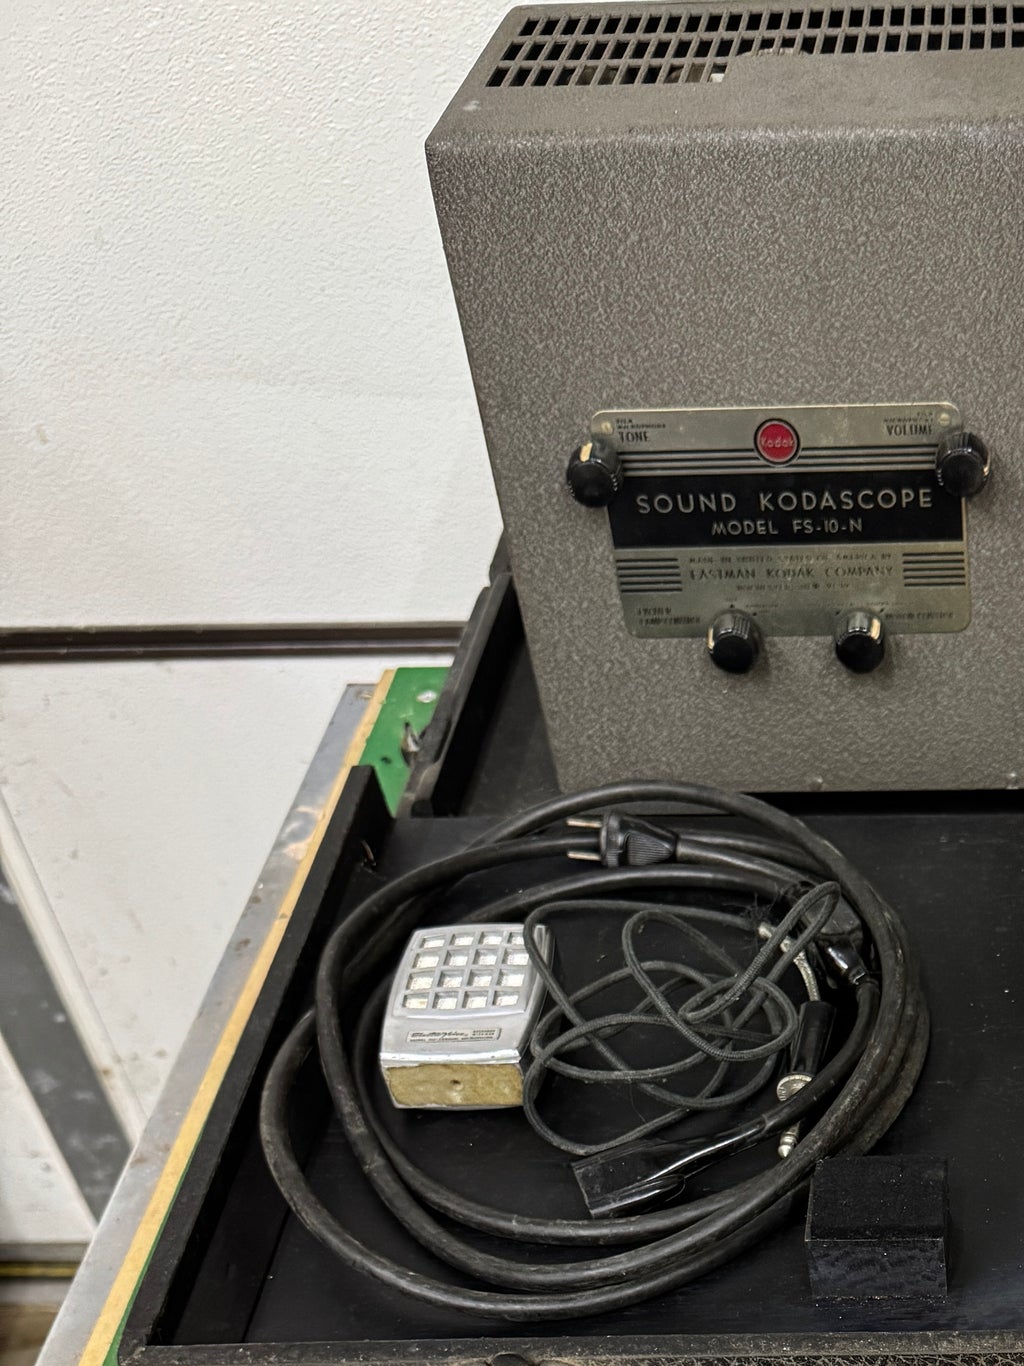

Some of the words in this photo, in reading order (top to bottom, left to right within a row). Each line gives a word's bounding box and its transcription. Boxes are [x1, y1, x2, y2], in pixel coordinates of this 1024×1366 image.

[761, 436, 794, 448] Kodak
[636, 494, 736, 514] SOUND
[759, 489, 932, 512] KODASCOPE
[711, 521, 778, 536] MODEL
[792, 518, 862, 534] FS-10-N
[689, 567, 756, 580] EASTMAN
[766, 566, 814, 579] KODAK
[825, 564, 893, 577] COMPANY
